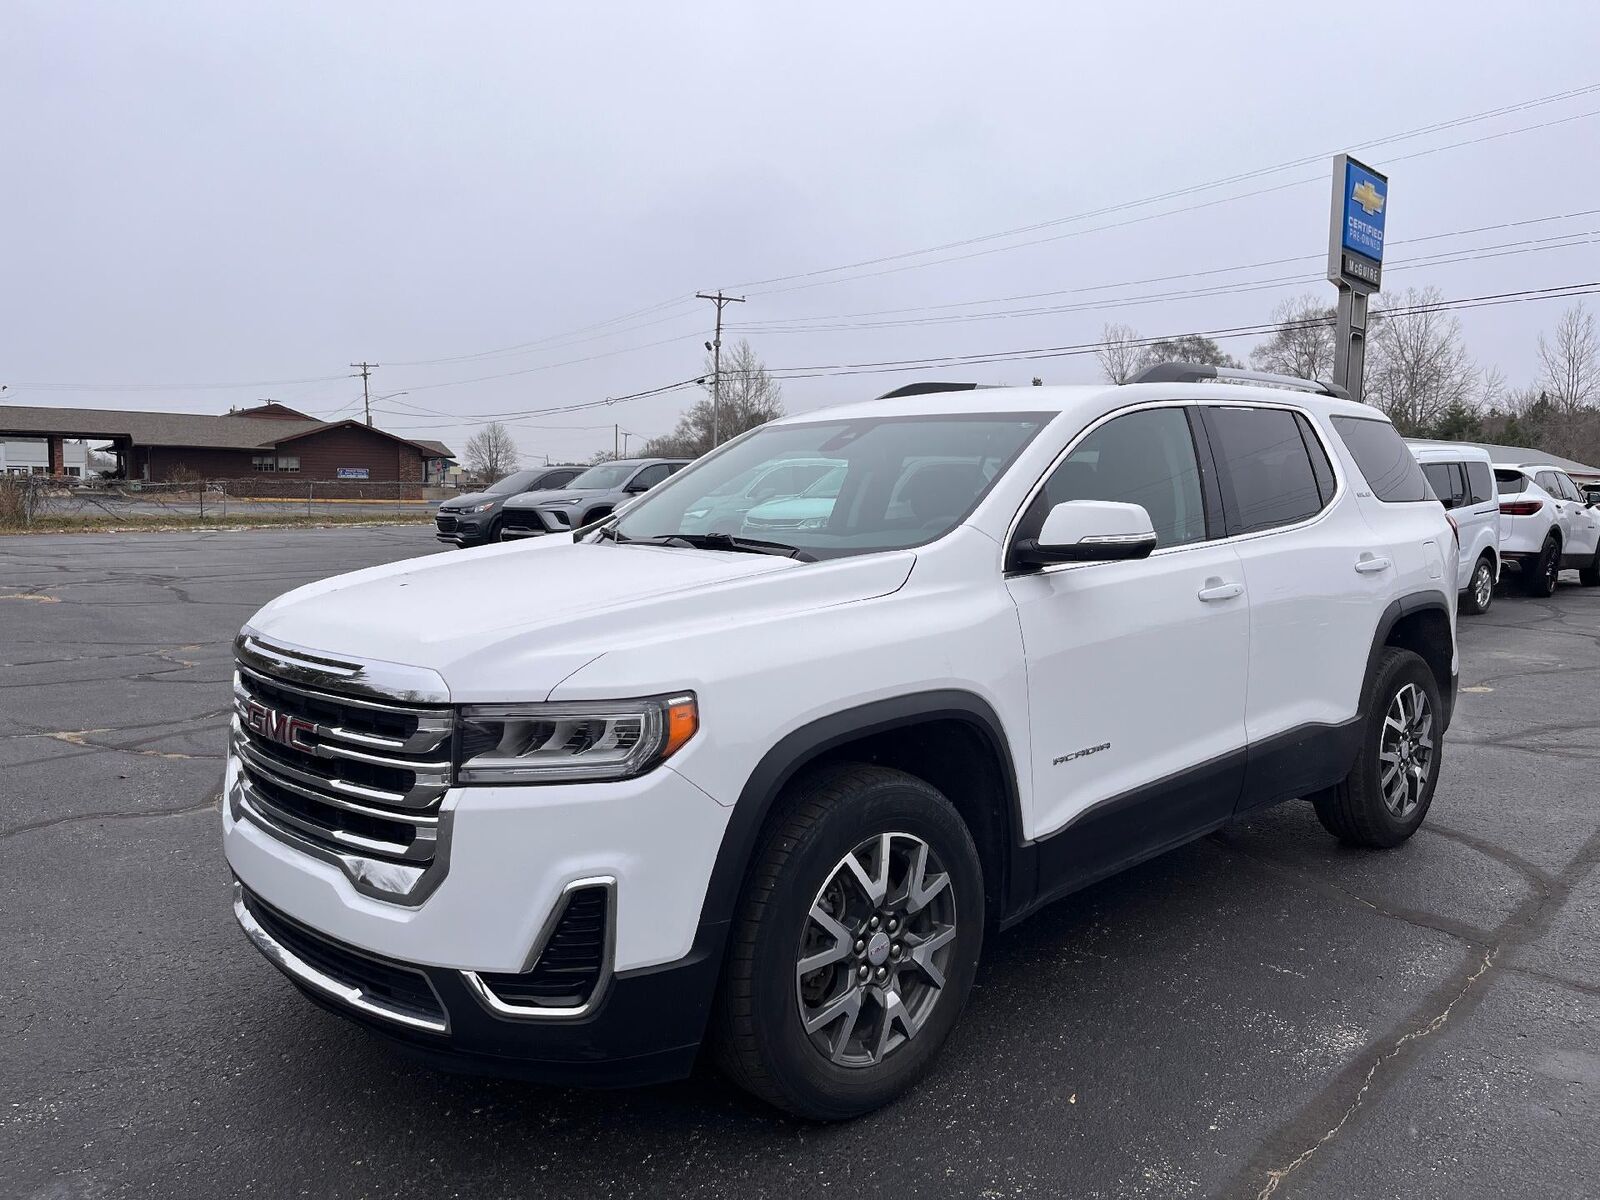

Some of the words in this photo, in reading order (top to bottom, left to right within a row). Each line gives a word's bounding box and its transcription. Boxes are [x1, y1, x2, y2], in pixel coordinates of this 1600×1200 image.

[1348, 216, 1382, 240] CERTIFIED
[1349, 228, 1380, 250] PRE-OWNED
[248, 700, 319, 756] GMC
[1052, 742, 1111, 766] ACADIA
